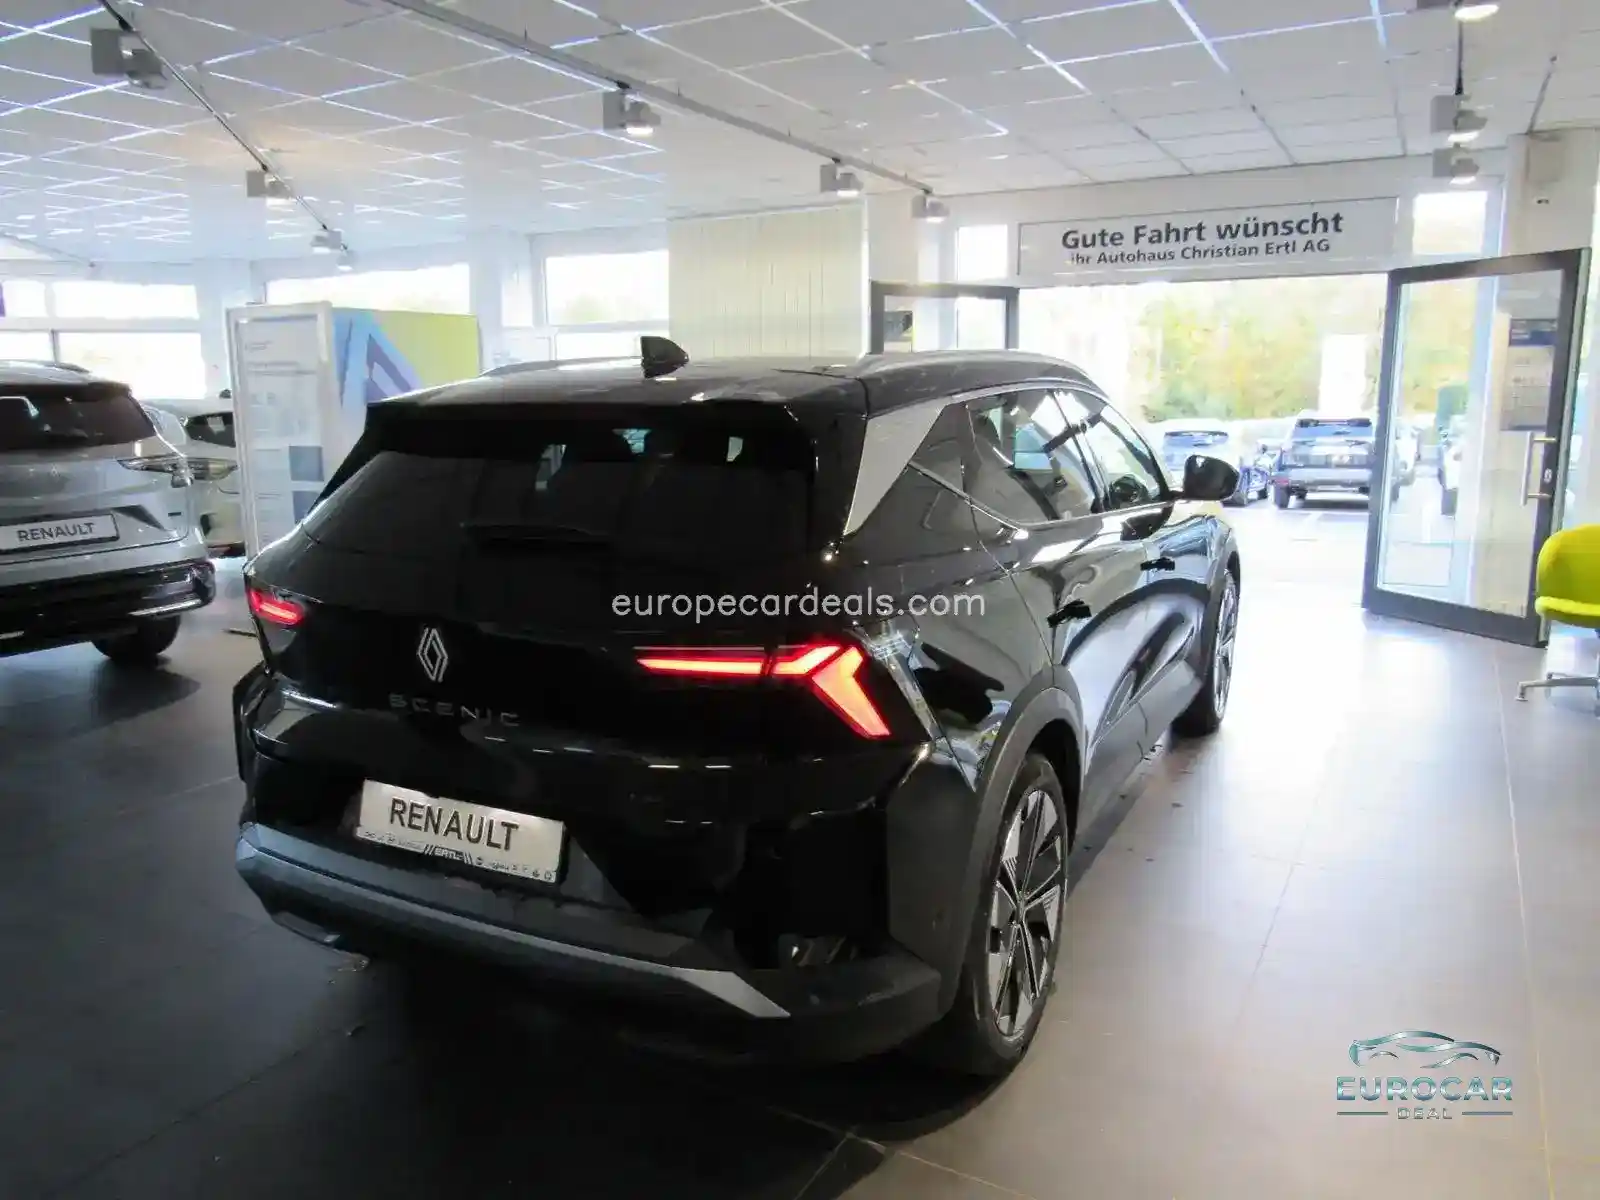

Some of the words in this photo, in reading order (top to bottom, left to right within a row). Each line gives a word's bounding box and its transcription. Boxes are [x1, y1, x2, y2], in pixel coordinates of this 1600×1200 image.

[1061, 229, 1125, 250] Gute
[1133, 221, 1206, 245] Fahrt
[1216, 211, 1344, 241] wünscht
[1096, 249, 1176, 265] Autohaus
[1181, 244, 1259, 261] Christian
[1265, 240, 1297, 255] Ertl
[1302, 238, 1331, 253] AG
[16, 522, 95, 541] RENAULT
[388, 693, 520, 727] SCENIC
[389, 797, 520, 851] RENAULT
